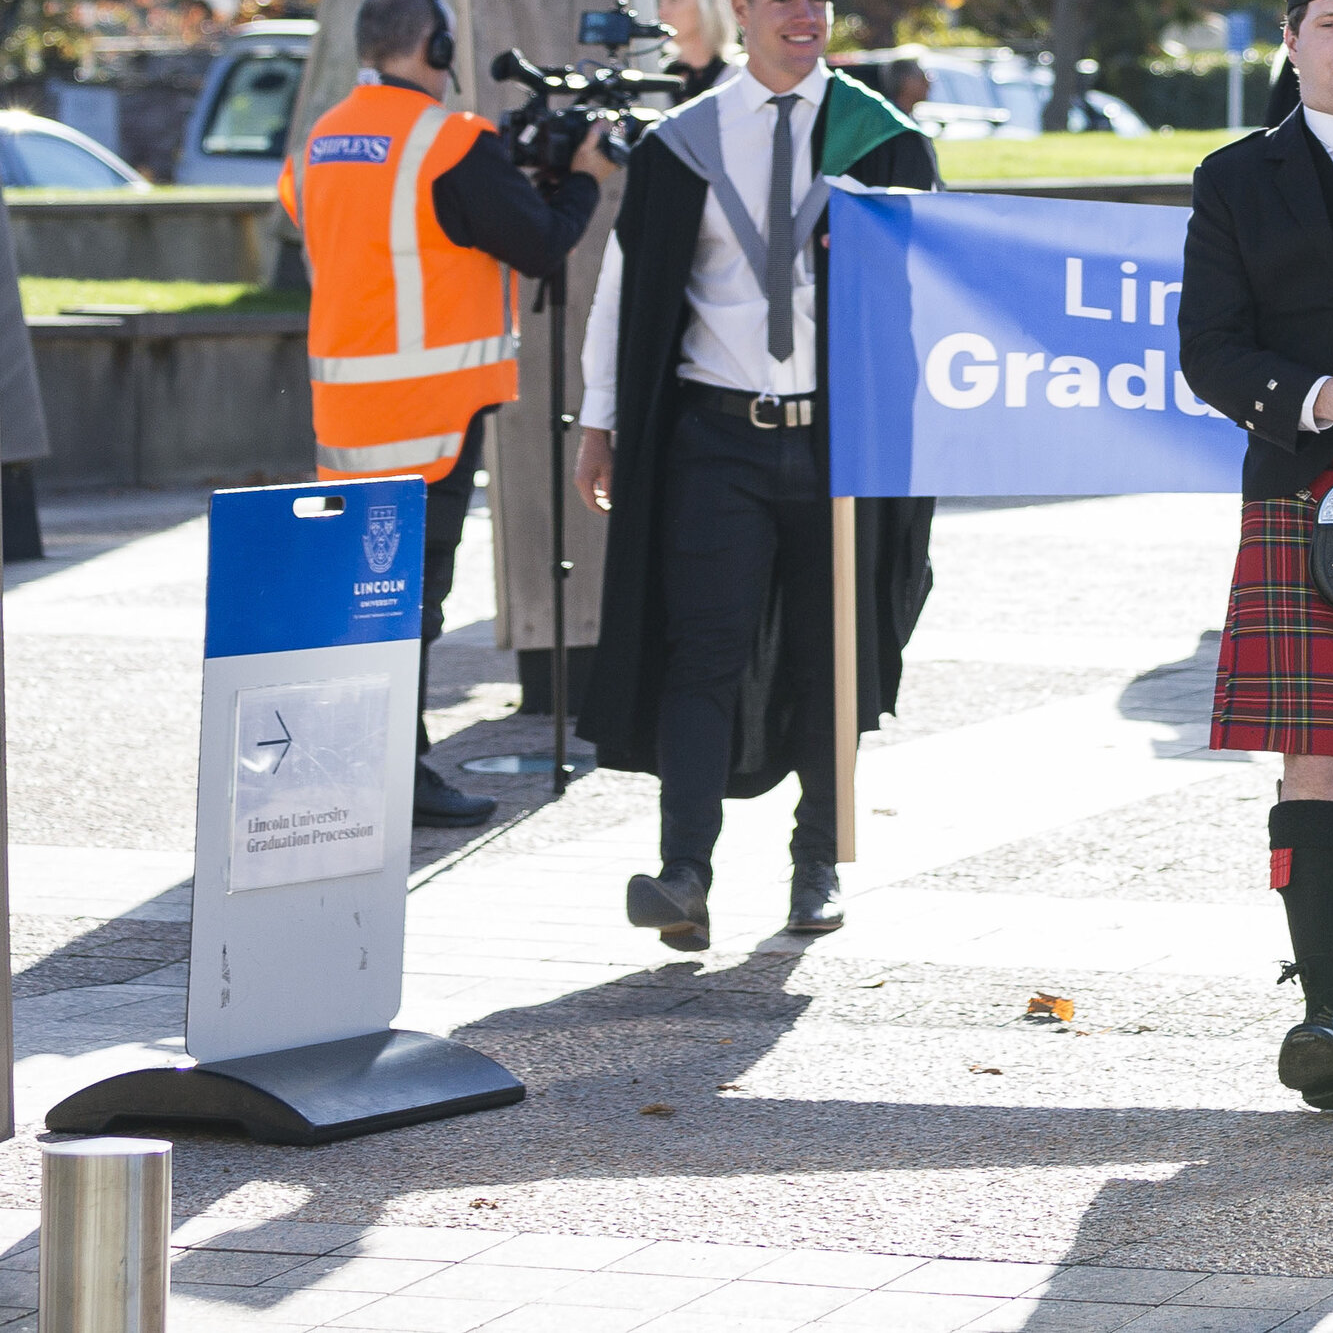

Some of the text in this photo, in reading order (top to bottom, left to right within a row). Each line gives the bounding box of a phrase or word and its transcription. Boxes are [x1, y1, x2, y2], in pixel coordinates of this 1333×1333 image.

[353, 579, 406, 595] LINCOLN
[247, 806, 350, 834] Lincoln University
[246, 822, 374, 853] Graduation Procession
